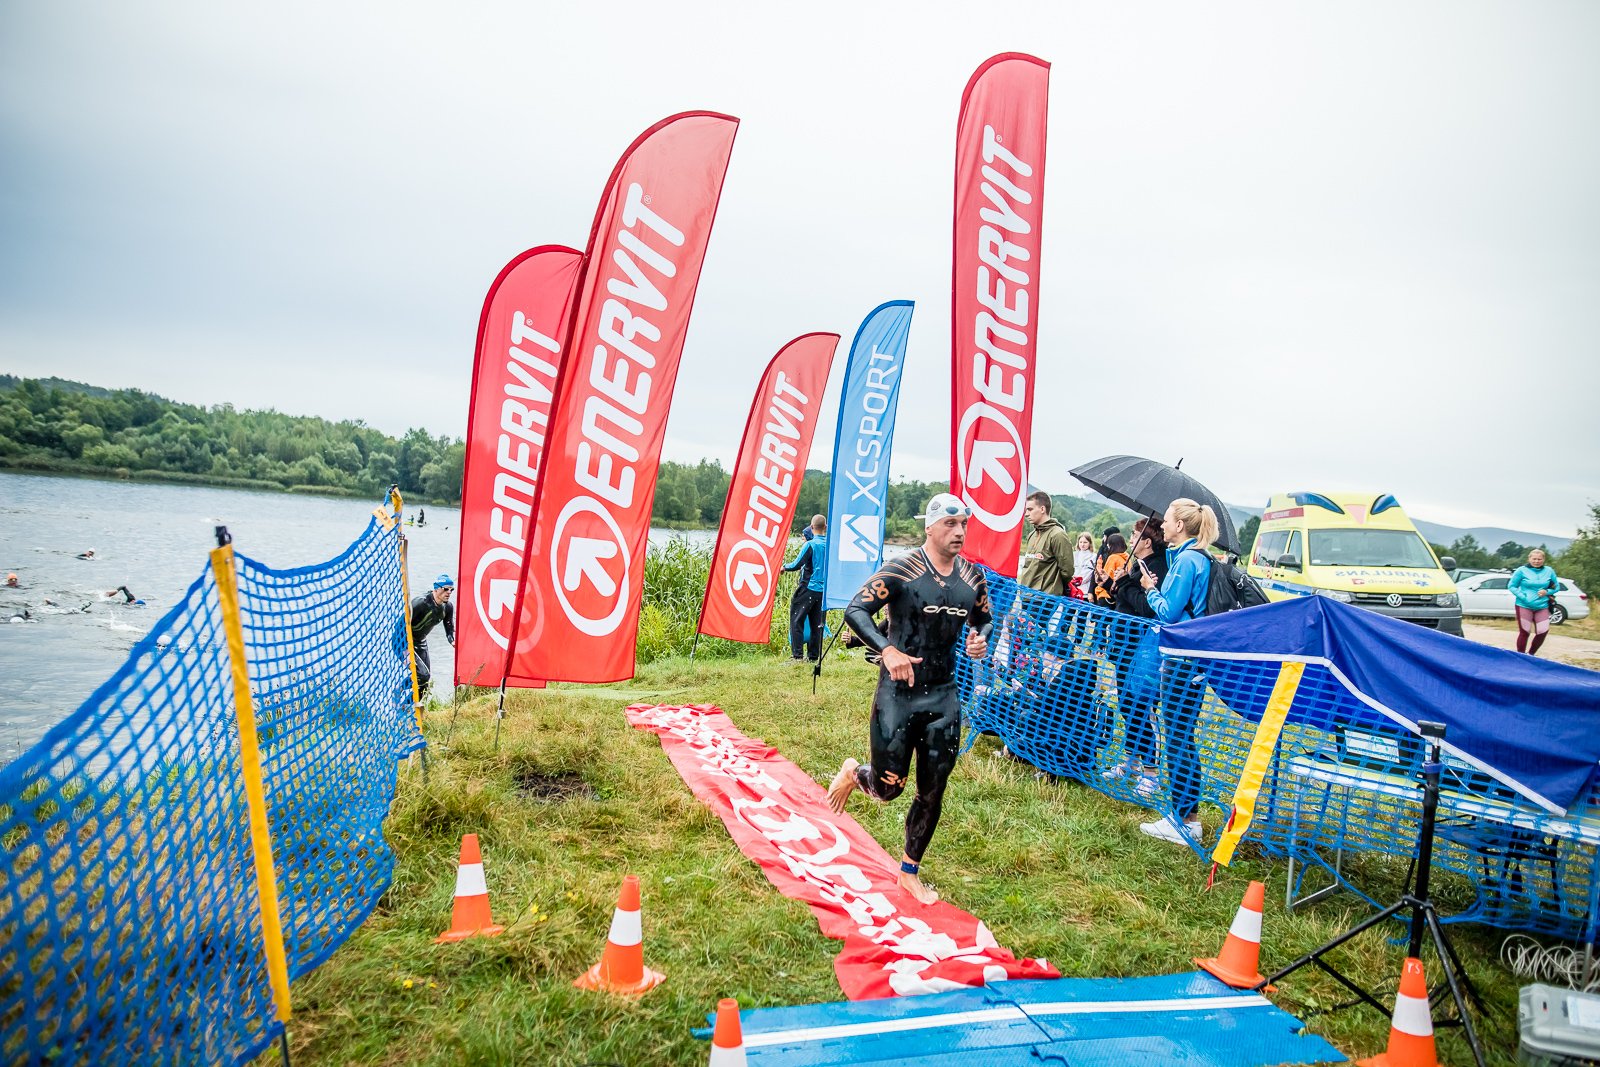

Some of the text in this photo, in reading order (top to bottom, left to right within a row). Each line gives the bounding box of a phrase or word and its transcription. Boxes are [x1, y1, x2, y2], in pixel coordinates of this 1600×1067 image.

[575, 182, 685, 509] ENERVIT
[974, 125, 1033, 413] ENERVIT
[744, 371, 809, 548] ENERVIT
[845, 344, 898, 507] XCSPORT
[923, 605, 968, 617] orca
